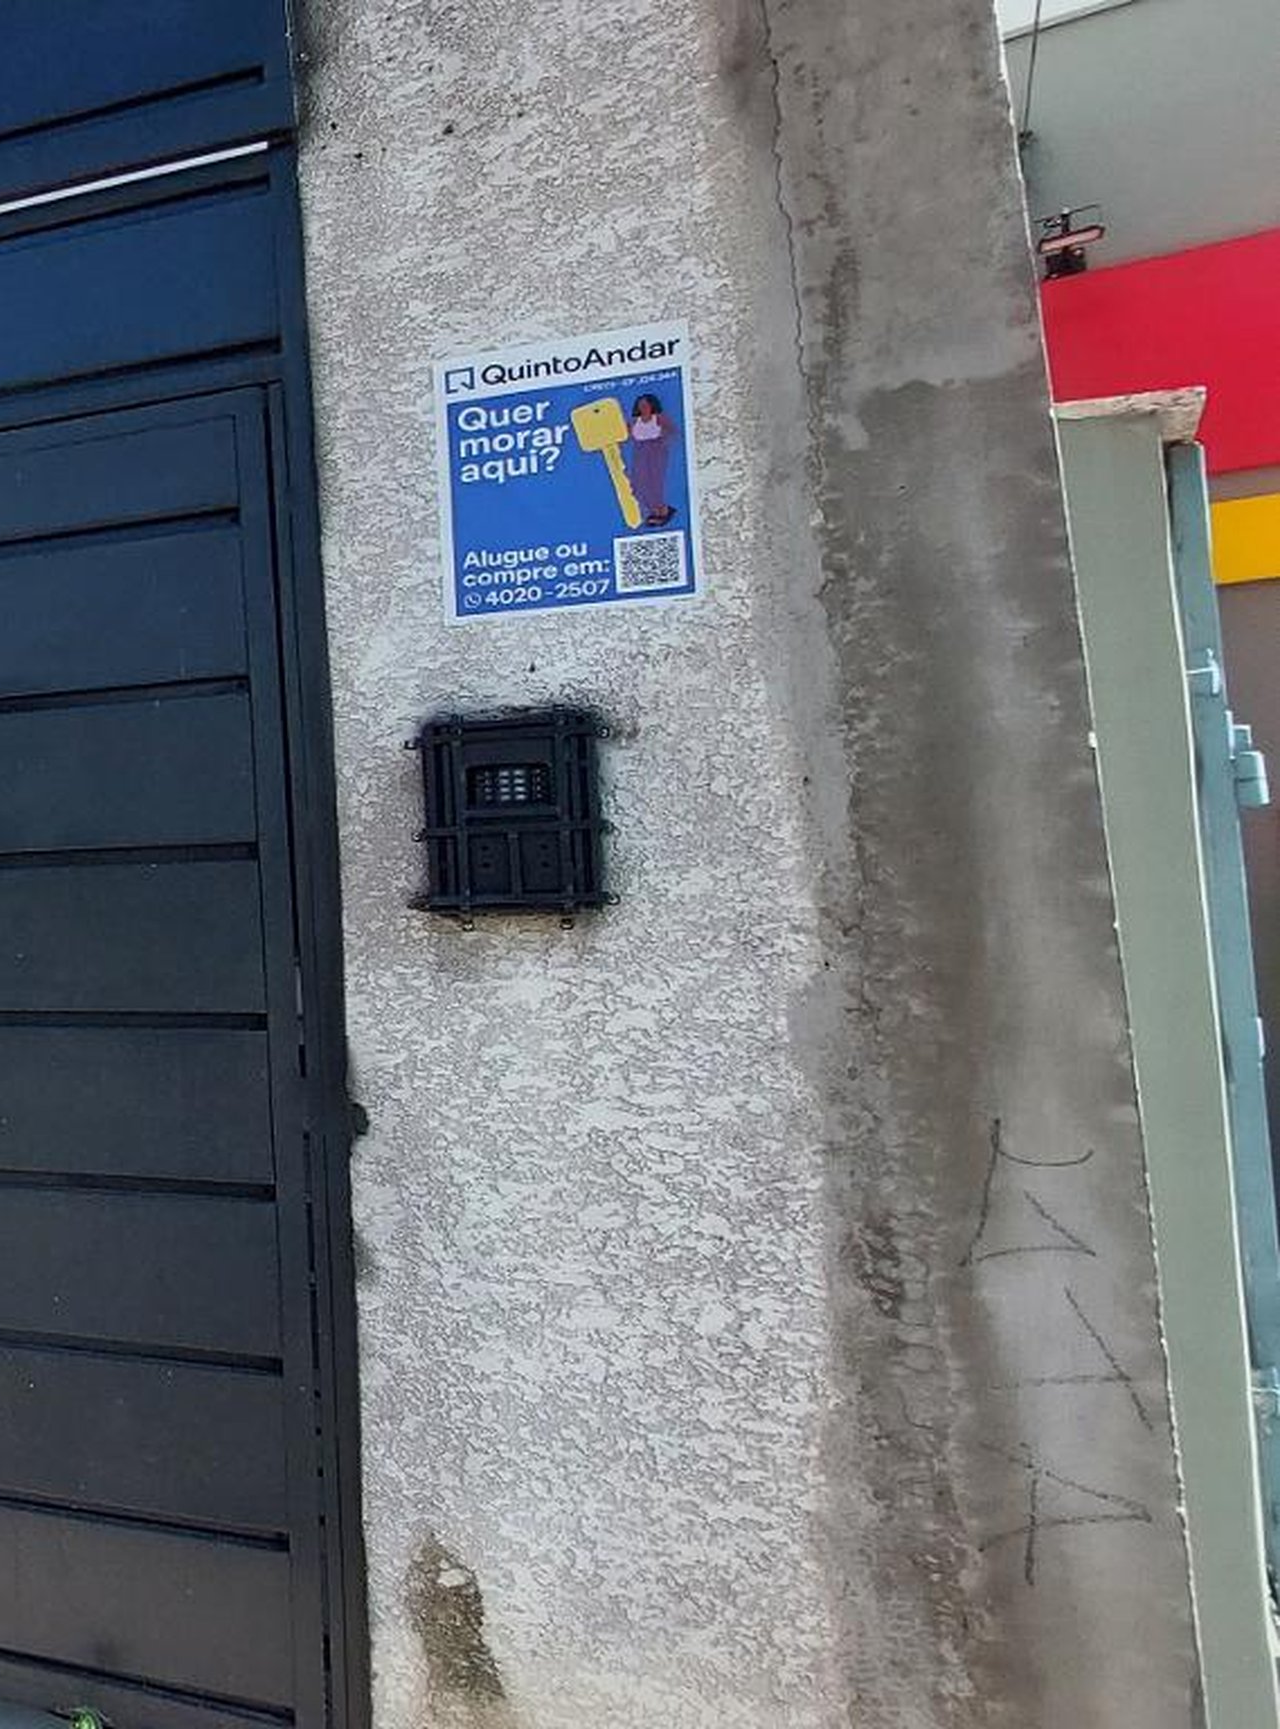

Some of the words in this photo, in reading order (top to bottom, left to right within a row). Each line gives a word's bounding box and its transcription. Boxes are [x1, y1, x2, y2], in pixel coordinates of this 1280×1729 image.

[481, 338, 681, 385] QuintoAndar
[458, 402, 550, 432] Quer
[460, 423, 570, 458] morar
[460, 447, 561, 484] aqui?
[463, 544, 549, 570] Alugue
[555, 542, 588, 558] ou
[463, 567, 558, 589] compre
[564, 557, 611, 576] em:
